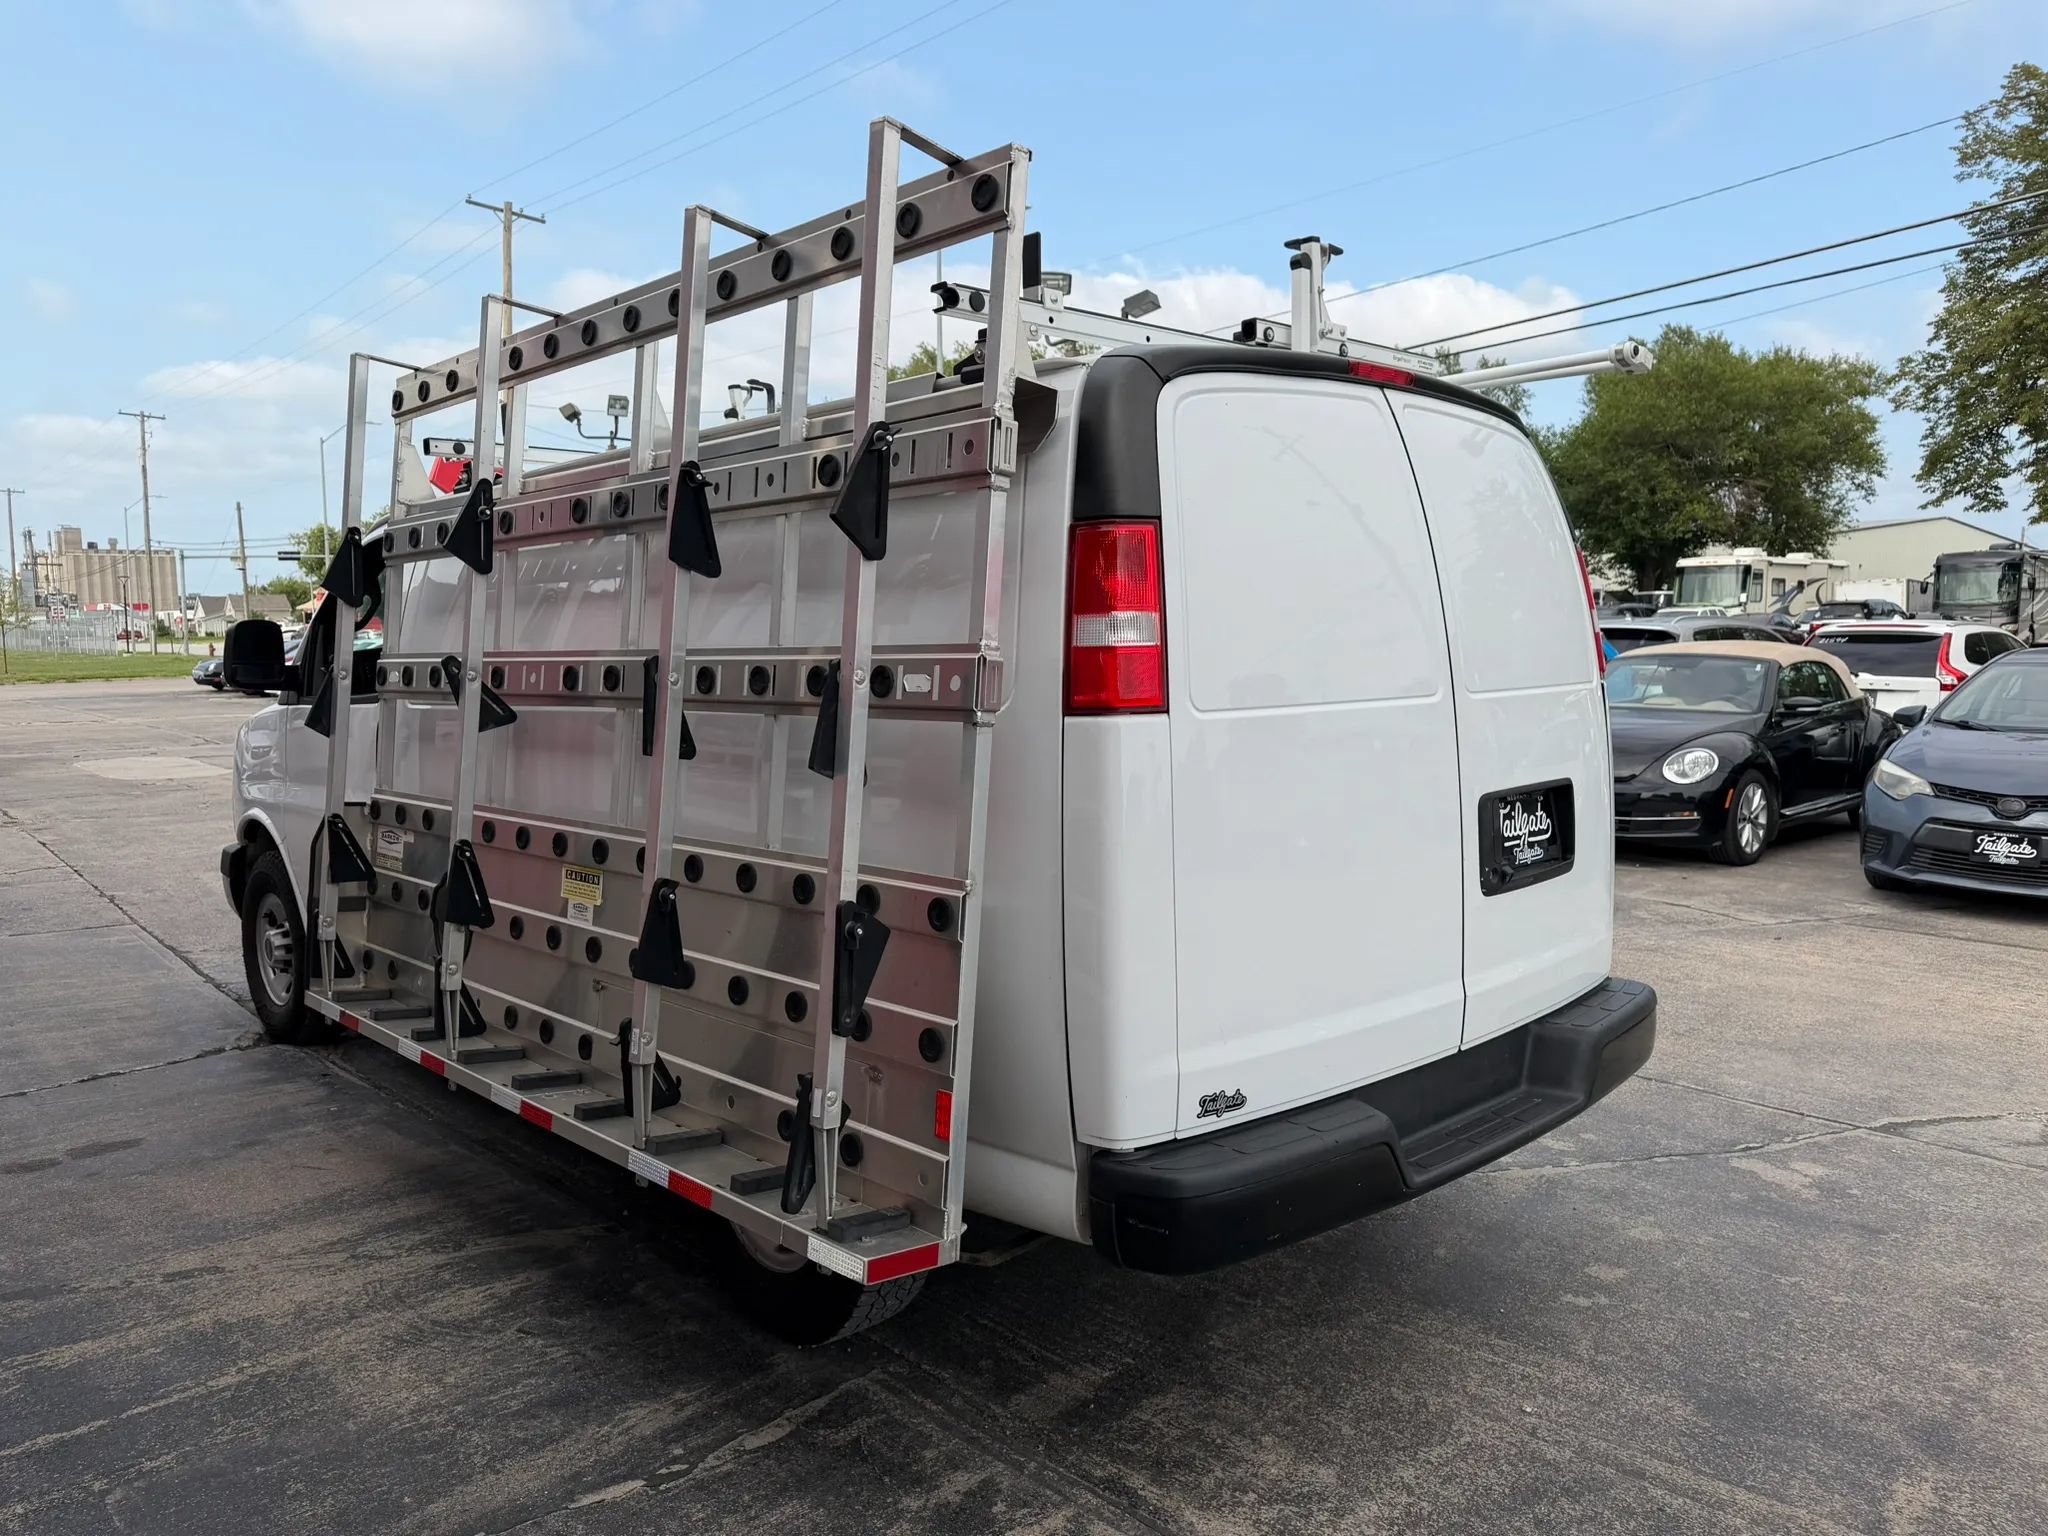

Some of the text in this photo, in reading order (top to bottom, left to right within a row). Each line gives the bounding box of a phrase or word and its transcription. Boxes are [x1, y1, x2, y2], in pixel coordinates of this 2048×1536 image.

[1499, 801, 1552, 848] Tailgate
[1513, 843, 1544, 865] Tailgate
[1974, 836, 2037, 858] Tailgate
[566, 870, 600, 885] CAUTION
[1197, 1088, 1248, 1119] Tailgate
